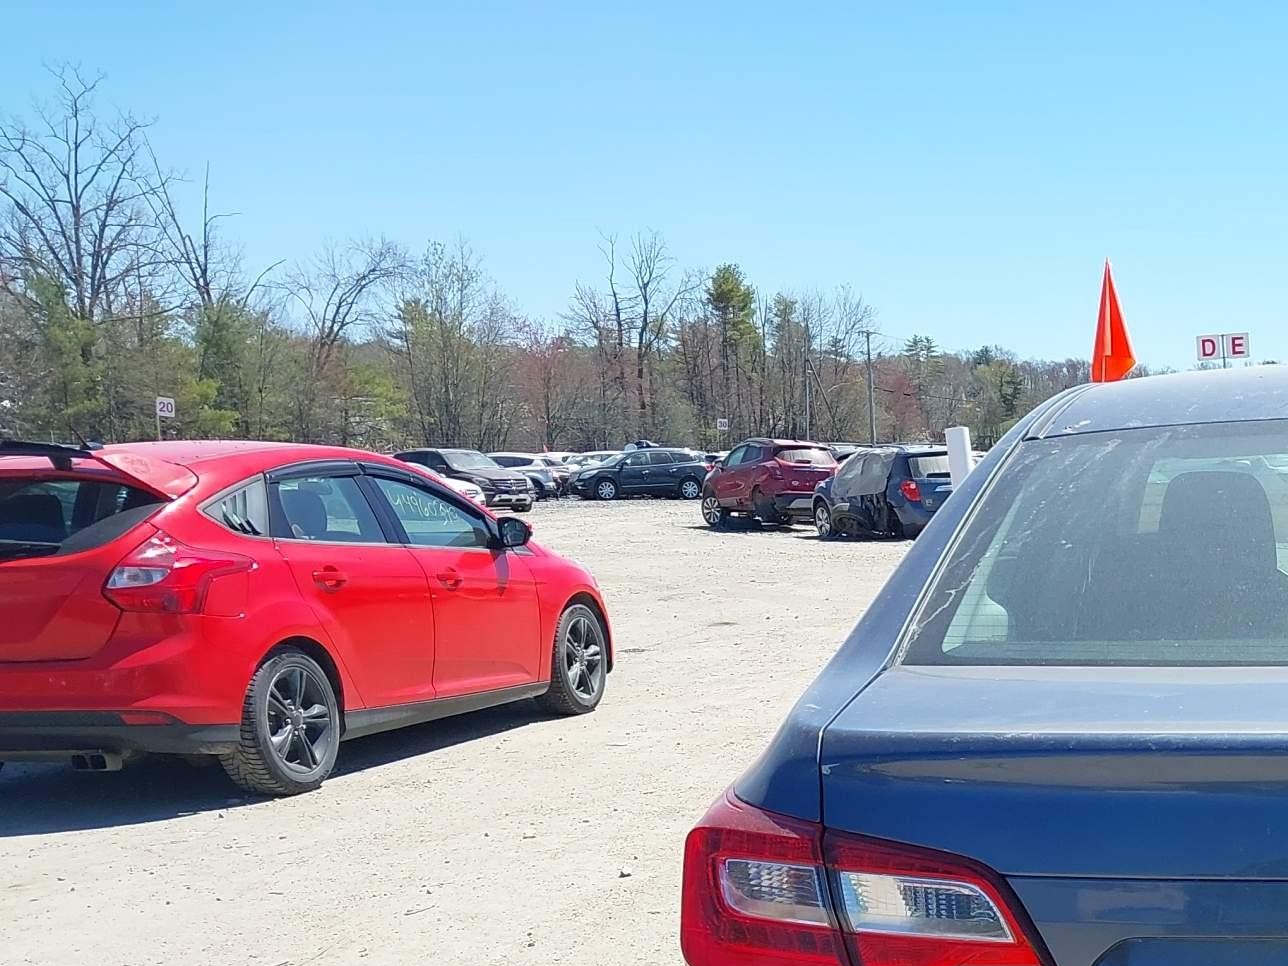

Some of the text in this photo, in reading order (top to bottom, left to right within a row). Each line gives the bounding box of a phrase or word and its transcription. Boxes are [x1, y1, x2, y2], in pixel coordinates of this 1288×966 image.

[1201, 338, 1217, 357] D
[1231, 336, 1246, 355] E
[158, 401, 174, 414] 20
